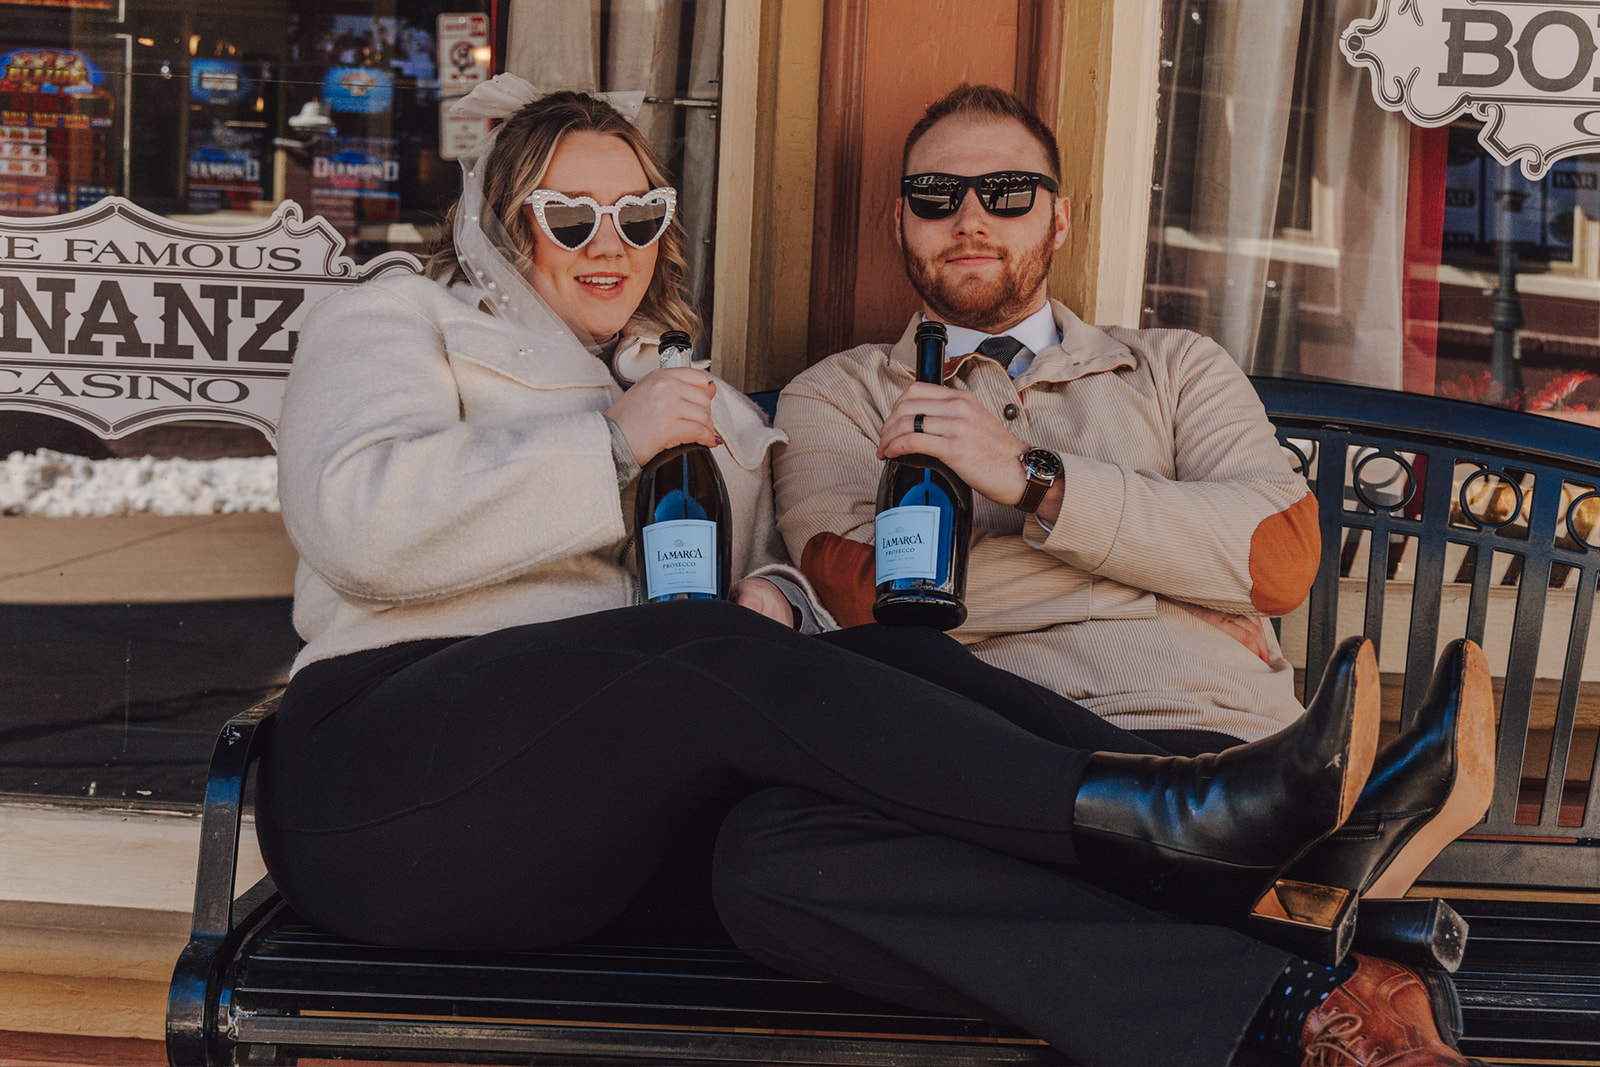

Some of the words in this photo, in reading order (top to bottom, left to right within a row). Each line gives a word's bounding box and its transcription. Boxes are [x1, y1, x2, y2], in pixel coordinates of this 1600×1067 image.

[1438, 8, 1600, 92] BO
[0, 236, 41, 261] E
[64, 238, 303, 272] FAMOUS
[885, 547, 915, 557] PROSECCO
[662, 561, 697, 569] PROSECCO
